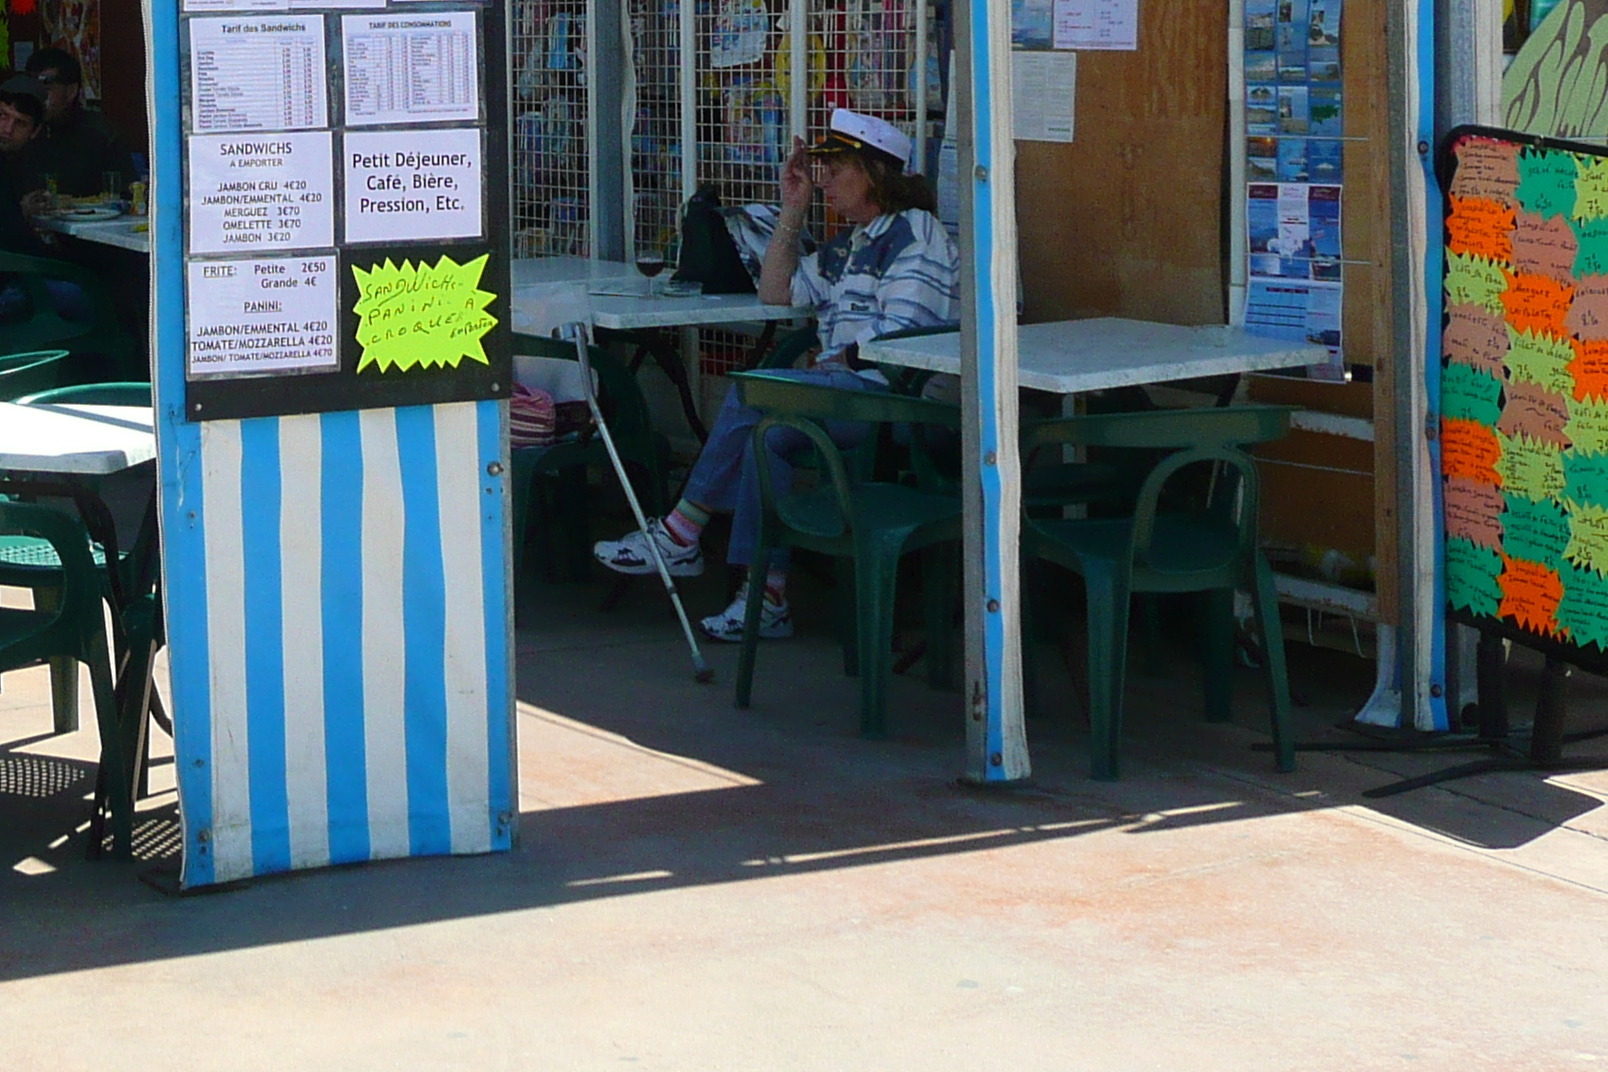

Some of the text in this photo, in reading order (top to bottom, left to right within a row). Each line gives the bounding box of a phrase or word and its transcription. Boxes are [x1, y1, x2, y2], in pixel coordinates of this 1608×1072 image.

[222, 23, 306, 33] Tarif des Sandwichs
[220, 142, 292, 156] SANDWICHS
[239, 158, 283, 167] EMPORTER
[352, 150, 472, 171] Petit Déjeuner,
[217, 181, 307, 192] JAMBON CRU 4€20
[366, 173, 458, 193] Café, Bière,
[201, 193, 322, 205] JAMBON/EMMENTAL 4€20
[224, 206, 300, 217] MERGUEZ 3€70
[360, 196, 465, 215] Pression, Etc.
[223, 219, 301, 230] OMELETTE 3€70
[223, 232, 291, 243] JAMBON 3€20
[203, 262, 326, 277] FRITE: Petite 2€50
[261, 277, 317, 289] Grande 4€
[244, 301, 282, 313] PANINI:
[196, 321, 328, 337] JAMBON/EMMENTAL 4€20
[192, 335, 333, 352] TOMATE/MOZZARELLA 4€20
[192, 349, 333, 364] JAMBON/ TOMATE/MOZZARELLA 4€70
